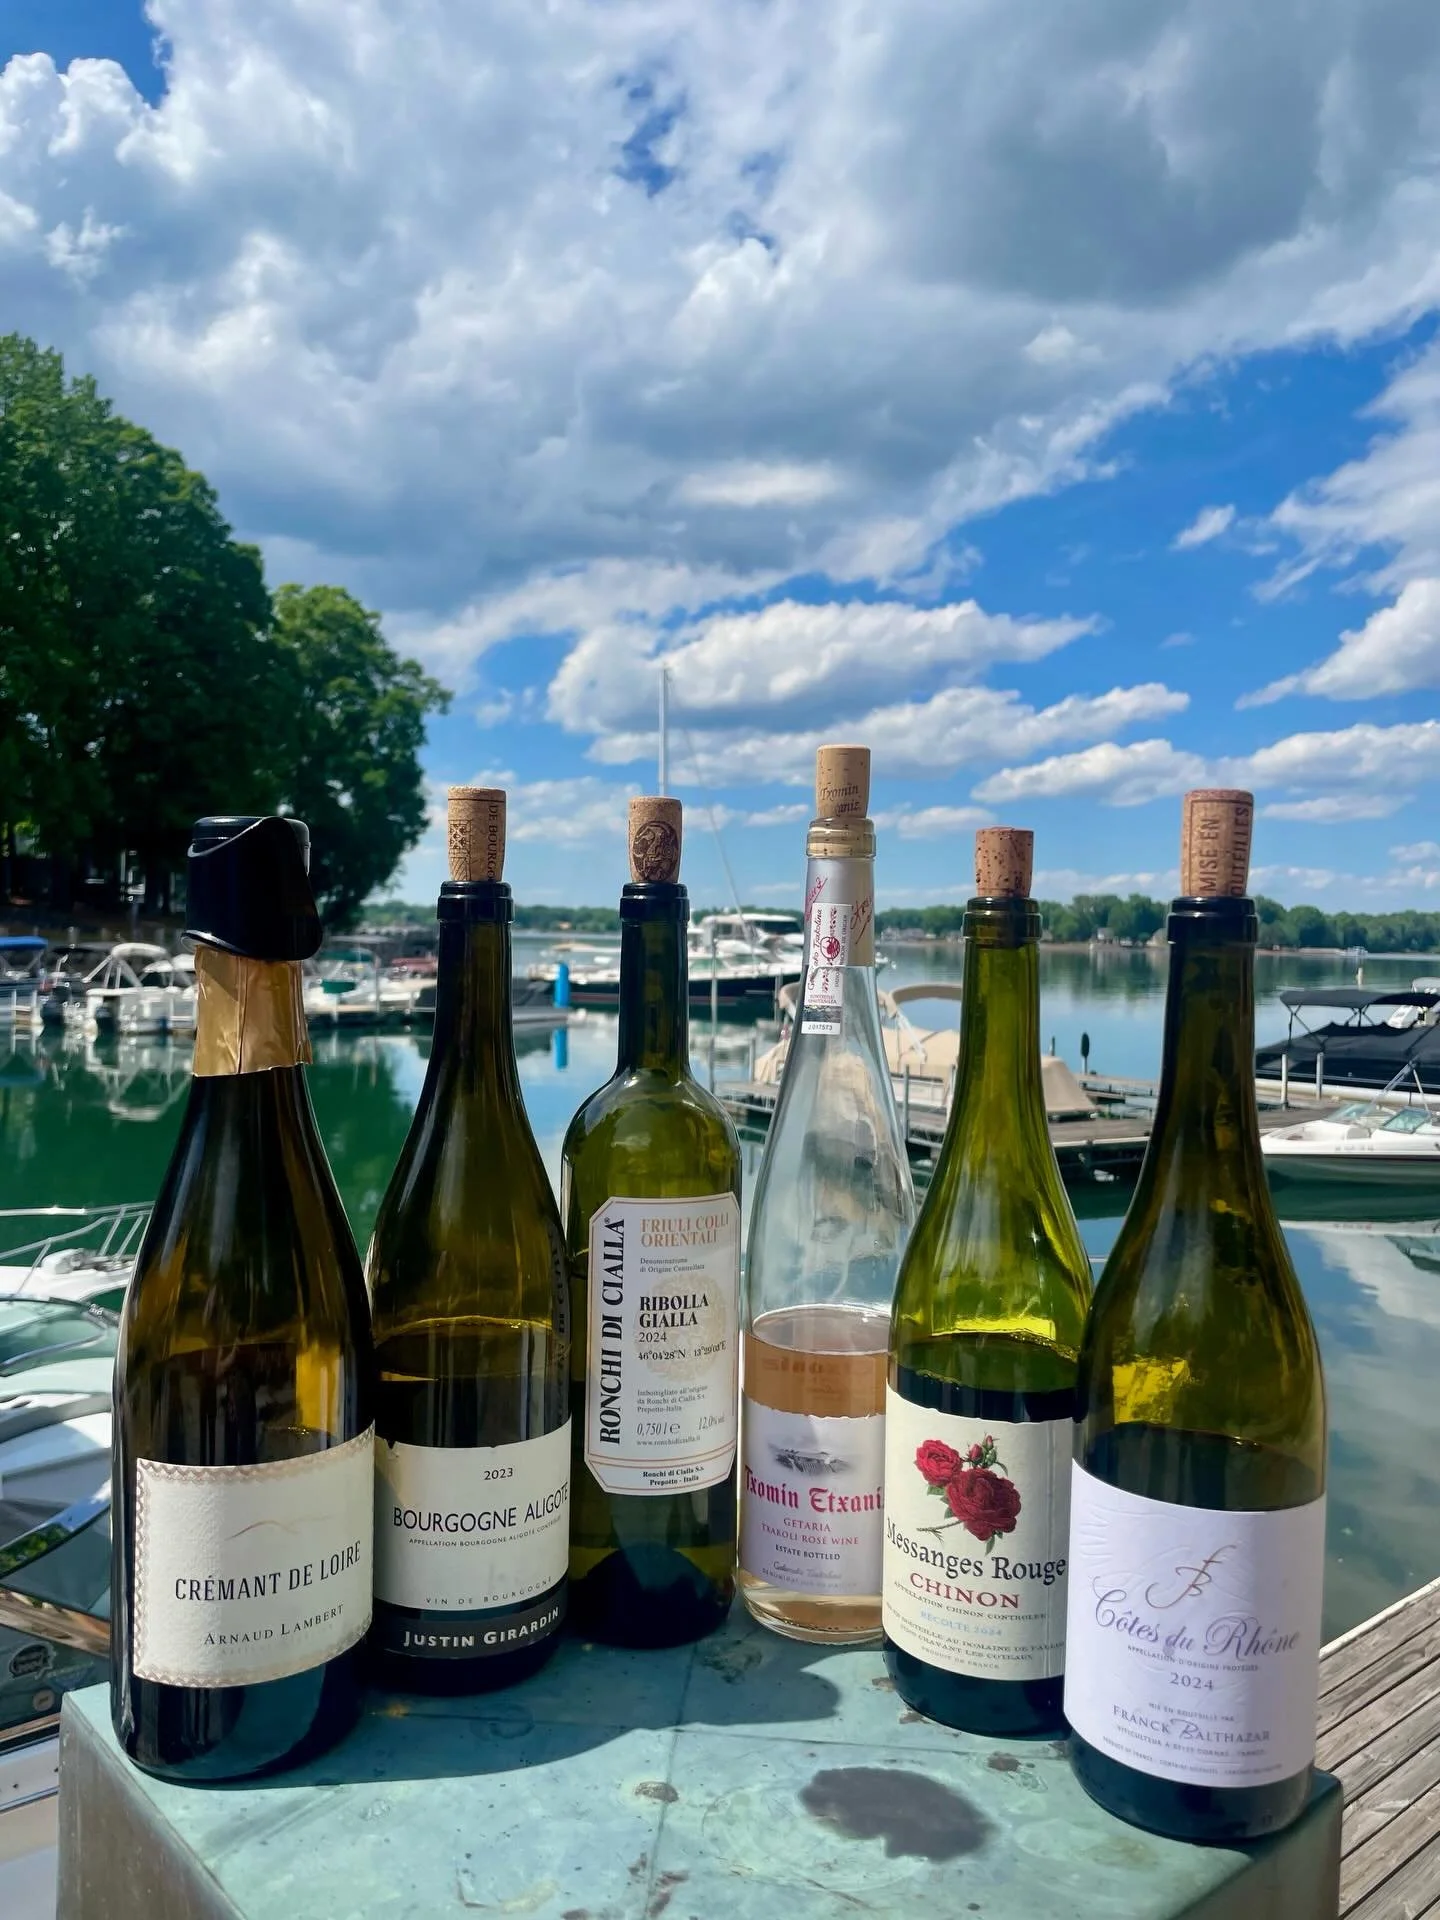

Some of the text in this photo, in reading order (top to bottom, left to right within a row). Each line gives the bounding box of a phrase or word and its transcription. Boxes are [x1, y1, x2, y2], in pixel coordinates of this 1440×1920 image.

[488, 804, 498, 820] DE
[1199, 818, 1219, 891] MISE EN
[641, 1212, 729, 1233] FRIULI COLLI
[641, 1229, 717, 1248] ORIENTALI
[640, 1293, 709, 1312] RIBOLLA
[601, 1314, 622, 1340] DI
[639, 1311, 698, 1329] GIALLA
[639, 1332, 668, 1343] 2024
[600, 1348, 621, 1445] RONCHI
[636, 1423, 662, 1436] 0,750
[484, 1467, 514, 1481] 2023
[650, 1478, 678, 1486] Prepotto
[683, 1475, 700, 1483] Italia
[676, 1468, 694, 1476] Cialla
[745, 1464, 884, 1514] Txomin Etxani
[393, 1506, 517, 1533] BOURGOGNE
[784, 1517, 831, 1532] GETARIA
[409, 1538, 457, 1547] APPELLATION
[460, 1537, 507, 1547] BOURGOGNE
[762, 1523, 798, 1542] TXAKOLI
[831, 1536, 860, 1546] WINE
[775, 1544, 841, 1560] ESTATE BOTTLED
[887, 1517, 1067, 1586] Messanges Rouge
[175, 1540, 361, 1602] CRÉMANT DE LOIRE
[484, 1576, 552, 1603] BOURGOGNE
[910, 1572, 1020, 1609] CHINON
[946, 1605, 984, 1618] CHINON
[204, 1628, 274, 1645] ARNAUD
[280, 1604, 344, 1636] LAMBERT
[404, 1606, 559, 1647] JUSTIN GIRARDIN
[1095, 1588, 1301, 1661] Côtes du Rhône
[962, 1641, 1011, 1652] DOMAINE
[966, 1650, 984, 1658] LES
[1127, 1644, 1176, 1664] APPELLATION
[1178, 1658, 1220, 1671] D'ORIGINE
[1170, 1672, 1215, 1692] 2024
[1112, 1704, 1271, 1743] FRANCK BALTHAZAR
